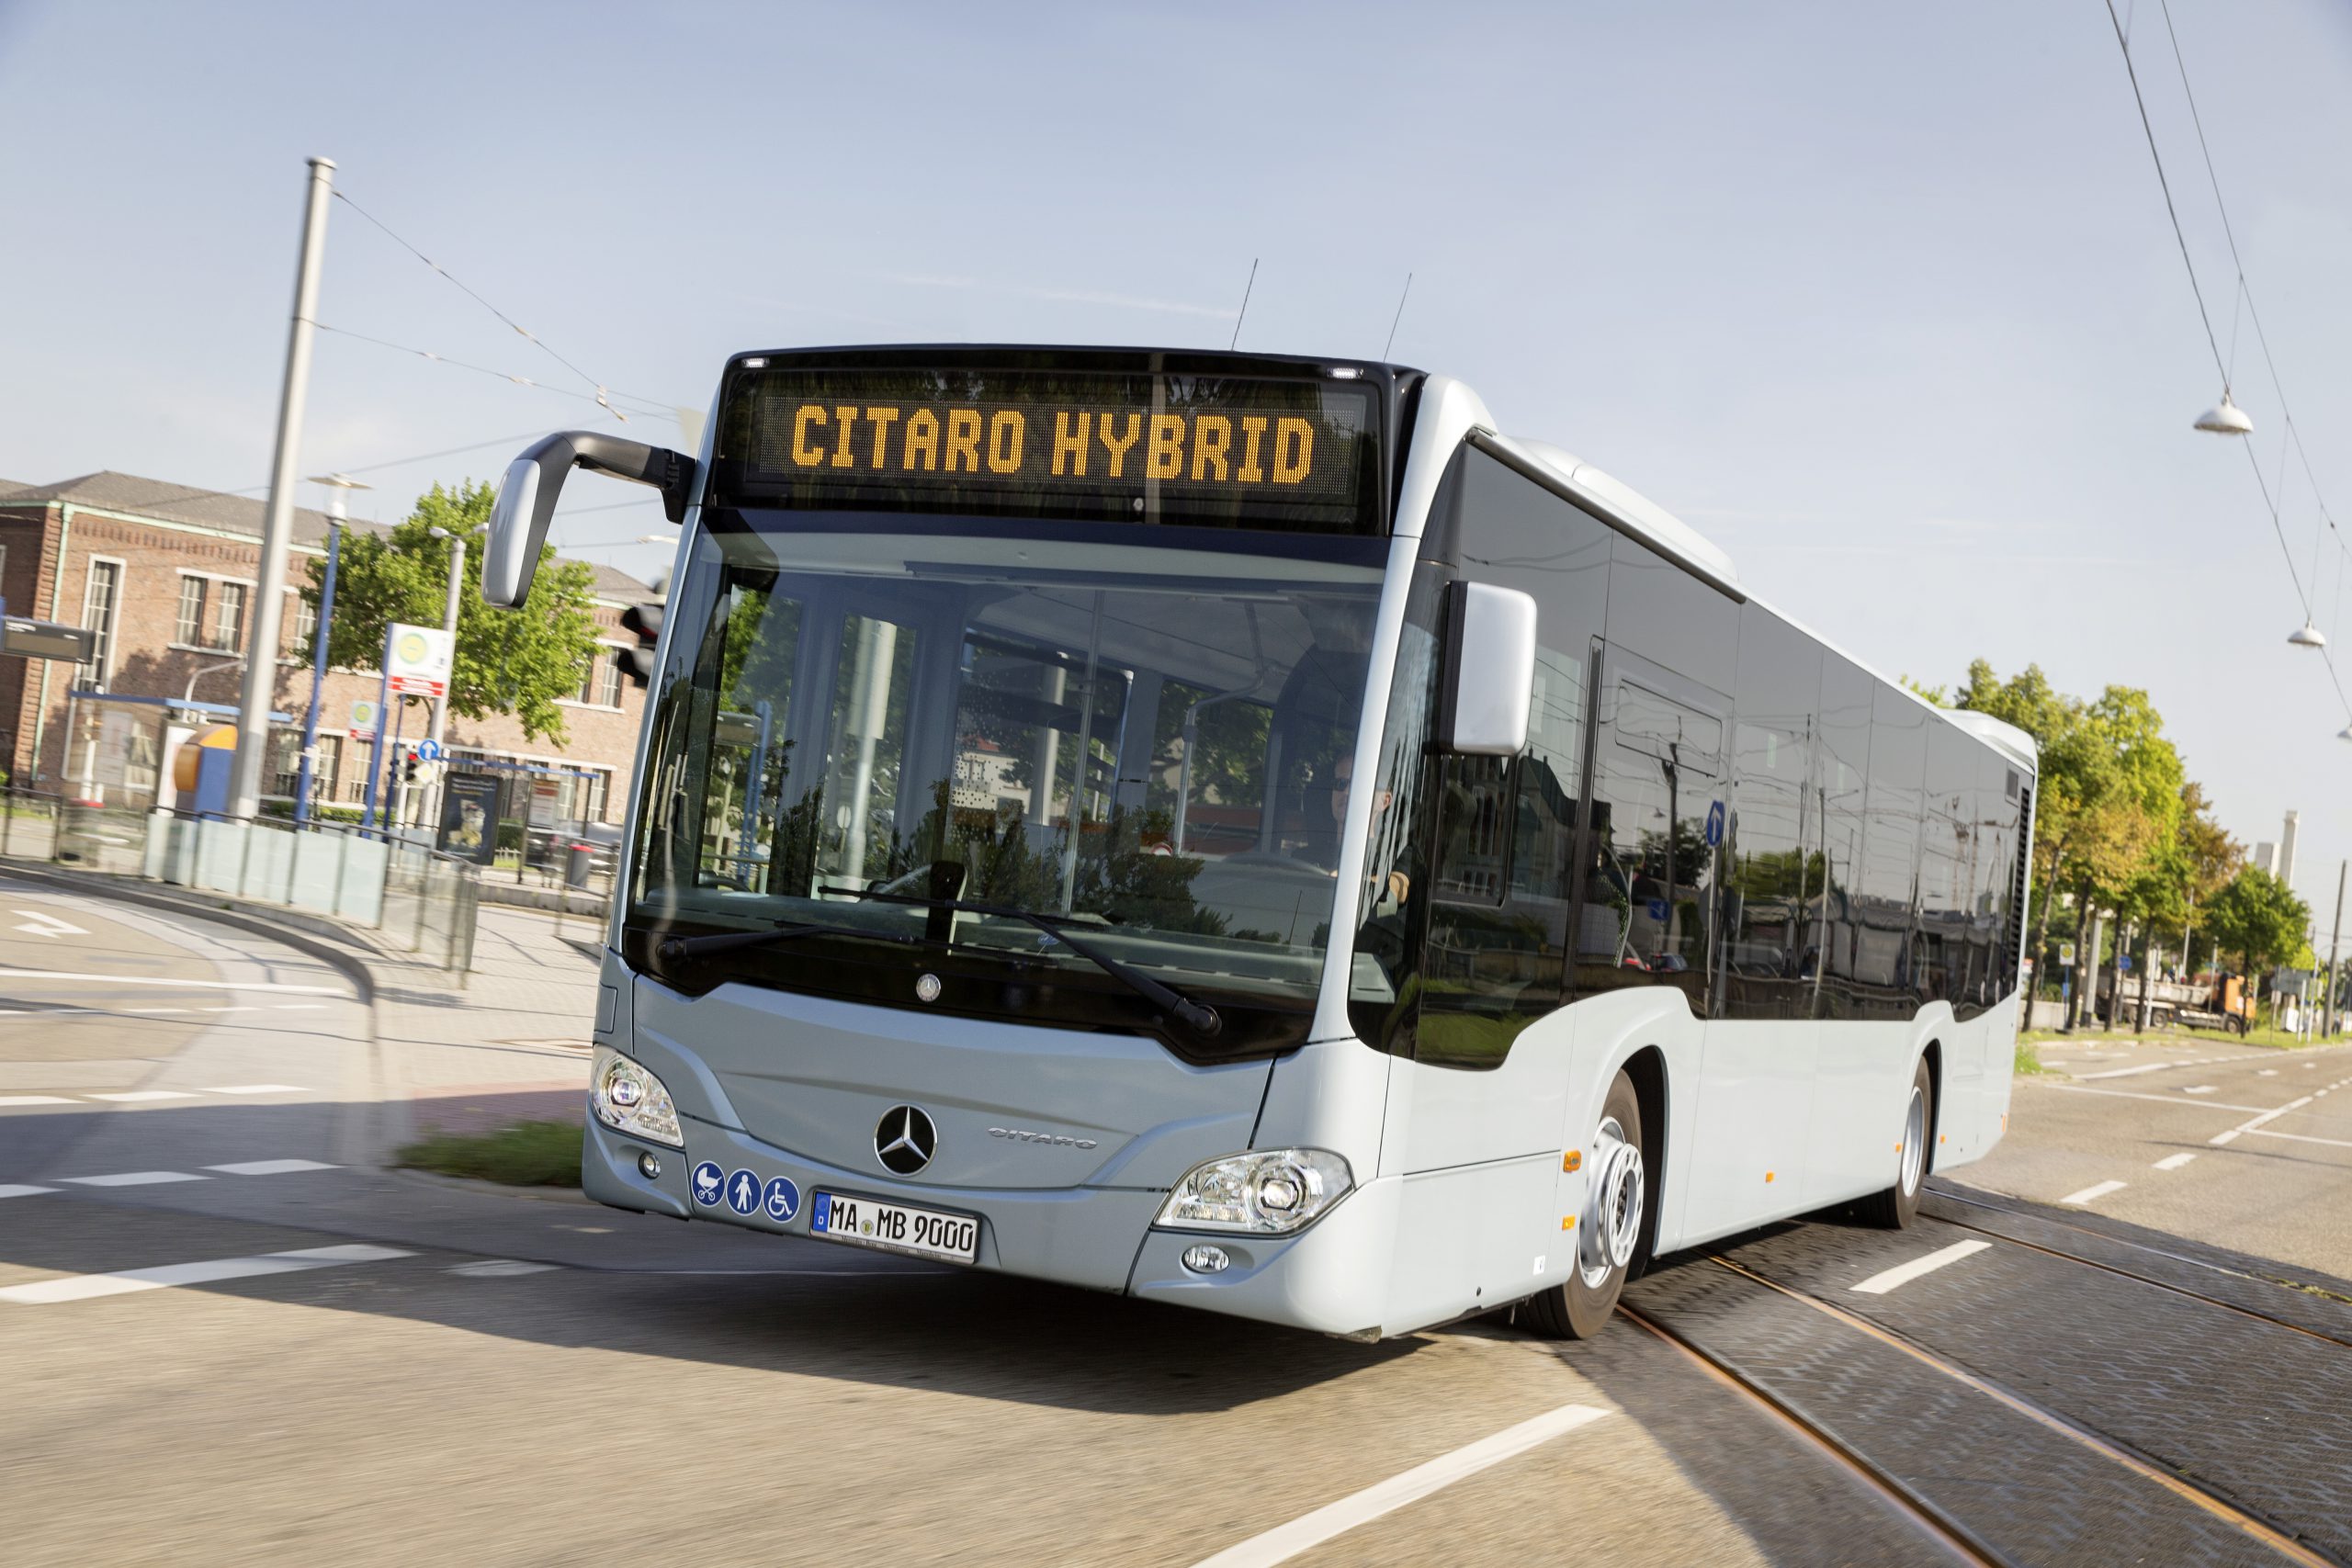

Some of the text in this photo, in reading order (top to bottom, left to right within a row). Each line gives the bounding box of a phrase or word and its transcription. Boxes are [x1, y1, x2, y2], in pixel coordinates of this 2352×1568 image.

[792, 405, 1314, 483] CITARO HYBRID
[988, 1127, 1098, 1149] CITARO
[830, 1200, 974, 1252] MA MB 9000
